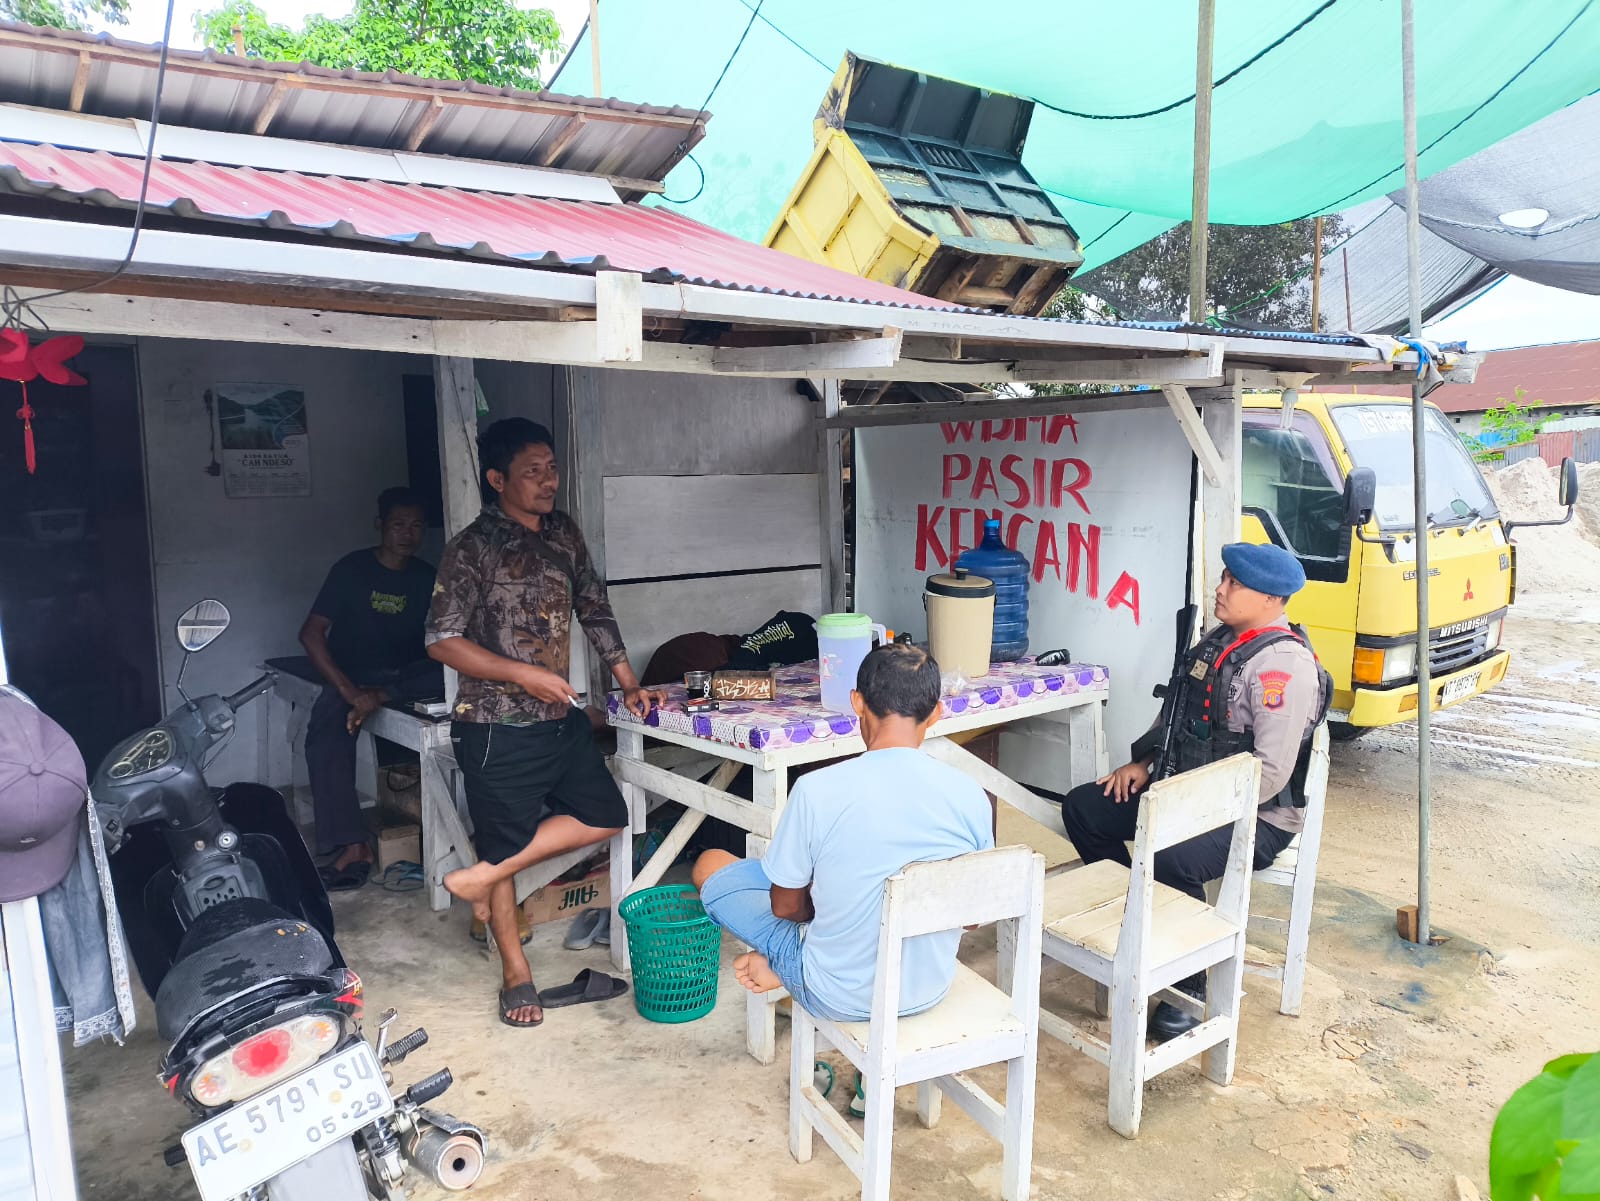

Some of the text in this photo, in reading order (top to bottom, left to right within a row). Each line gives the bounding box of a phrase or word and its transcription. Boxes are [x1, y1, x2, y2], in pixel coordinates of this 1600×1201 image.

[942, 453, 1092, 515] PASIR
[1440, 615, 1488, 638] MITSUBISHI
[557, 884, 599, 911] Alif
[197, 1052, 374, 1166] AE 5791 SU
